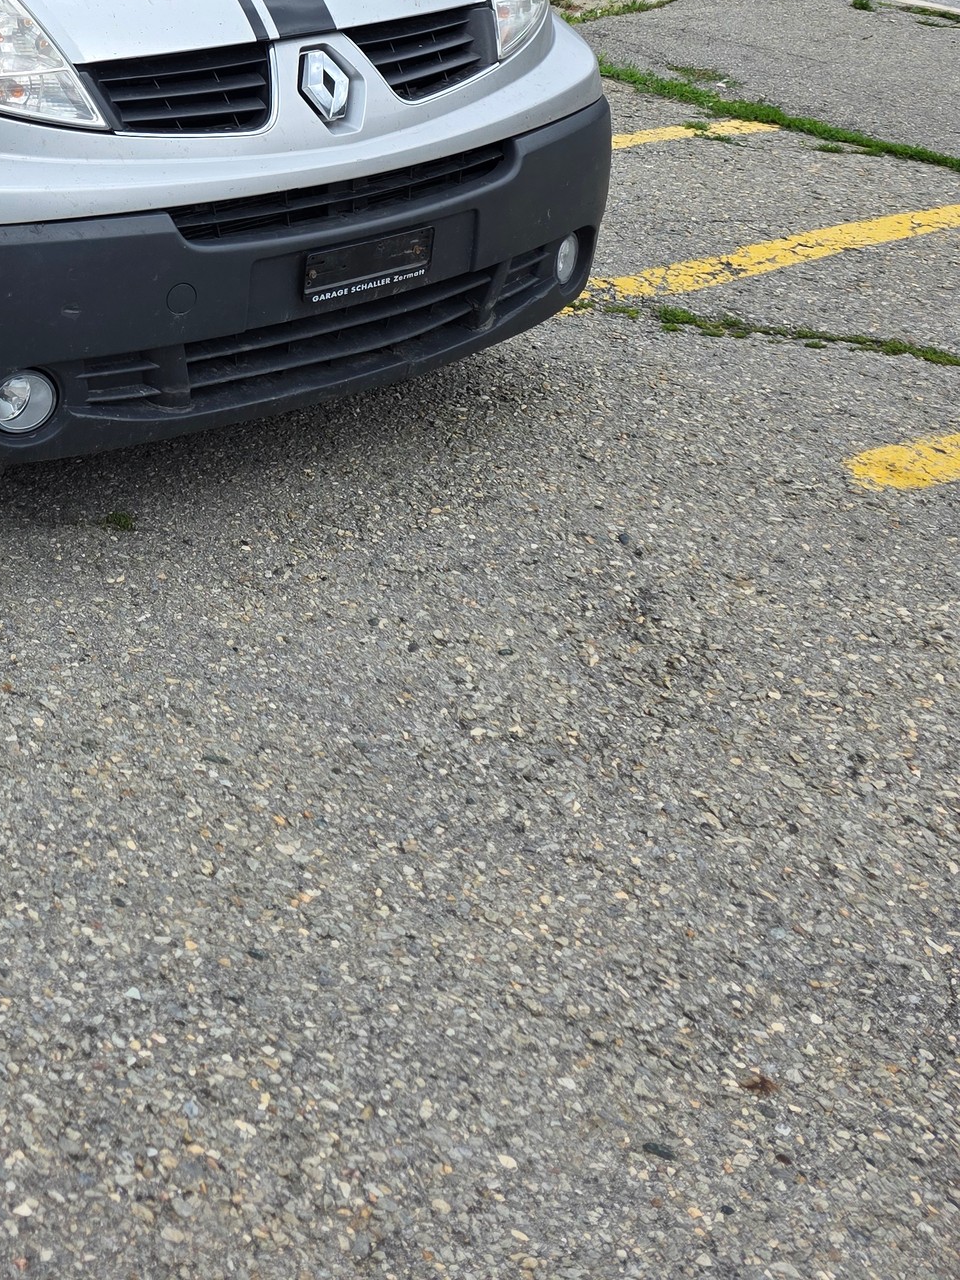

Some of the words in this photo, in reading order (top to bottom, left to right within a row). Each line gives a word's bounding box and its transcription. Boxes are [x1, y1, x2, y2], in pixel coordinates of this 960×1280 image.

[312, 288, 348, 302] GARAGE
[351, 277, 390, 293] SCHALLER
[393, 269, 425, 283] Zermatt
